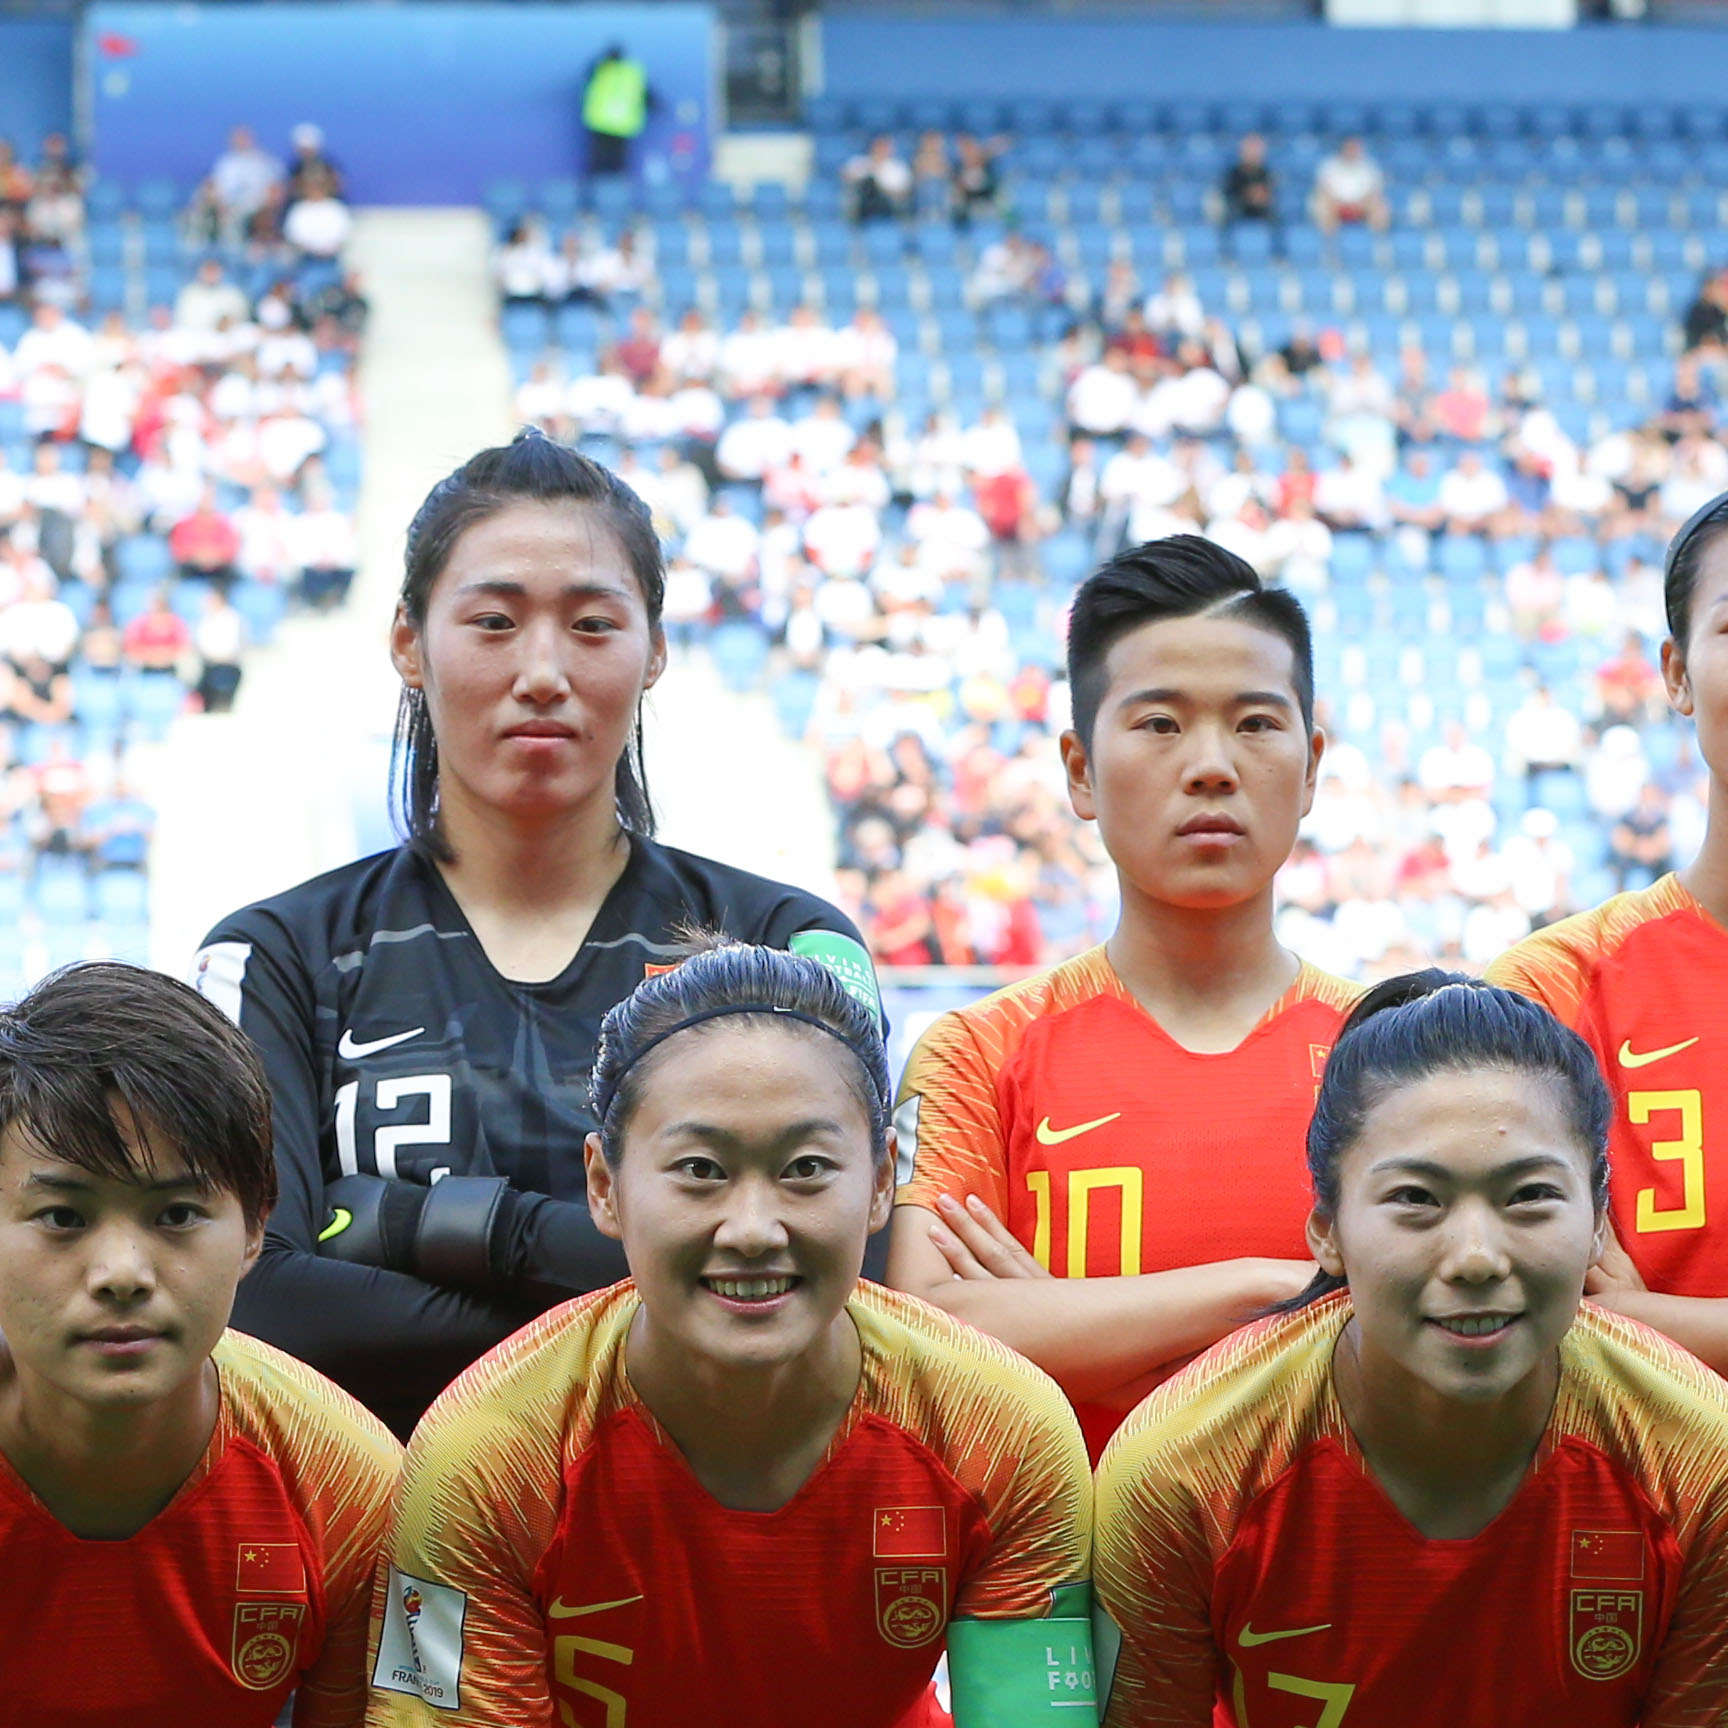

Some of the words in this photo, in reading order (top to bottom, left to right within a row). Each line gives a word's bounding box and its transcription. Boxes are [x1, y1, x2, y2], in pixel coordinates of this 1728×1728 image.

[334, 1073, 451, 1186] 12
[1627, 1088, 1706, 1233] 3
[1026, 1166, 1143, 1279] 10
[880, 1571, 939, 1585] CFA
[1576, 1595, 1636, 1612] CFA
[240, 1607, 298, 1623] CFA
